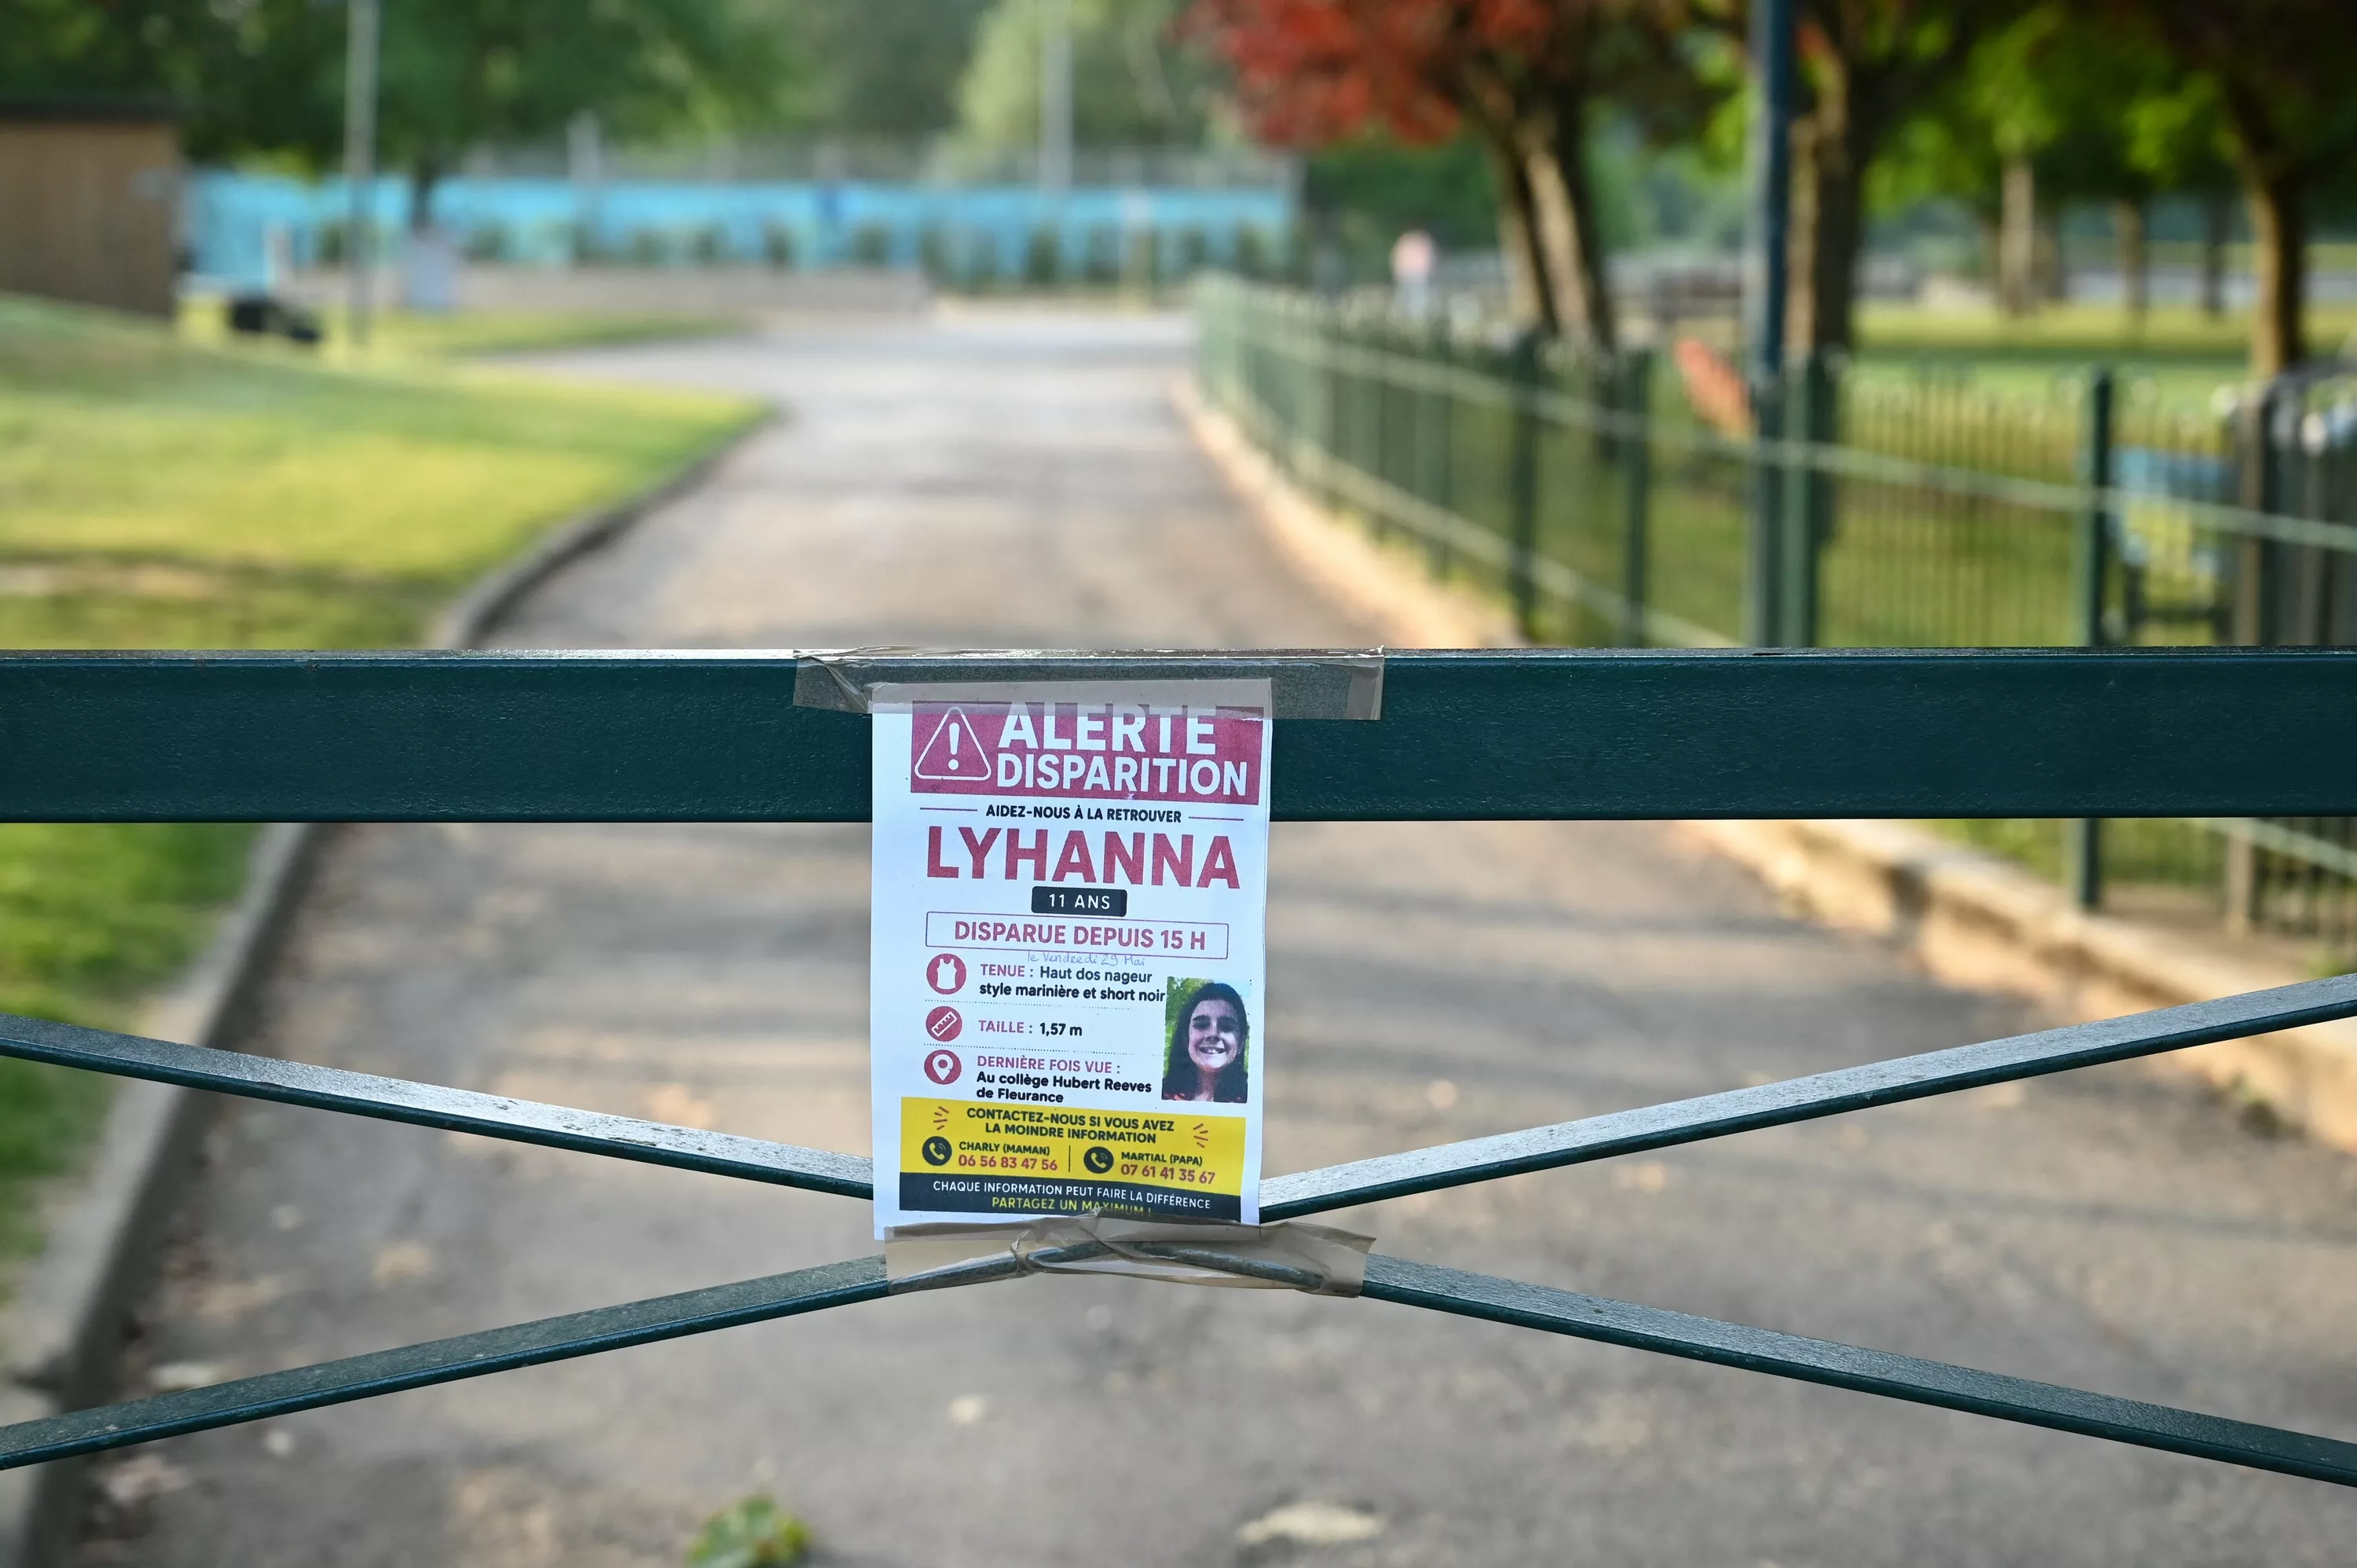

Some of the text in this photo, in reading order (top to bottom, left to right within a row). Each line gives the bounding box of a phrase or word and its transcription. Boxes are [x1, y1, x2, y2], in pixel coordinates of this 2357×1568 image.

[998, 702, 1216, 754] ALERTE
[997, 753, 1247, 796] DISPARITION
[986, 804, 1182, 822] AIDEZ-NOUS À LA RETROUVER
[927, 826, 1240, 889] LYHANNA
[1049, 894, 1110, 910] 11 ANS
[955, 921, 1205, 950] DISPARUE DEPUIS 15 H
[1124, 954, 1146, 966] Mai
[980, 964, 1025, 976] TENUE
[1040, 965, 1072, 980] Haut
[1076, 968, 1100, 981] dos
[1105, 971, 1153, 985] nageur
[980, 983, 1166, 1002] style marinière et short noir
[978, 1020, 1025, 1033] TAILLE
[1039, 1022, 1066, 1037] 1,57
[1069, 1026, 1083, 1036] m
[977, 1055, 1045, 1070] DERNIÈRE
[1050, 1059, 1080, 1072] FOIS
[1085, 1061, 1112, 1074] VUE
[977, 1072, 1152, 1093] Au collège Hubert Reeves
[977, 1087, 1064, 1103] de Fleurance
[967, 1108, 1175, 1131] CONTACTEZ-NOUS SI VOUS AVEZ
[985, 1123, 1157, 1144] LA MOINDRE INFORMATION
[959, 1141, 1050, 1156] CHARLY (MAMAN)
[959, 1155, 1058, 1171] 06 56 83 47 56
[1121, 1152, 1203, 1167] MARTIAL (PAPA)
[1120, 1164, 1215, 1185] 07 61 41 35 67
[933, 1181, 1211, 1209] CHAQUE INFORMATION PEUT FAIRE LA DIFFÉRENCE
[992, 1196, 1055, 1210] PARTAGEZ
[1060, 1199, 1077, 1211] UN
